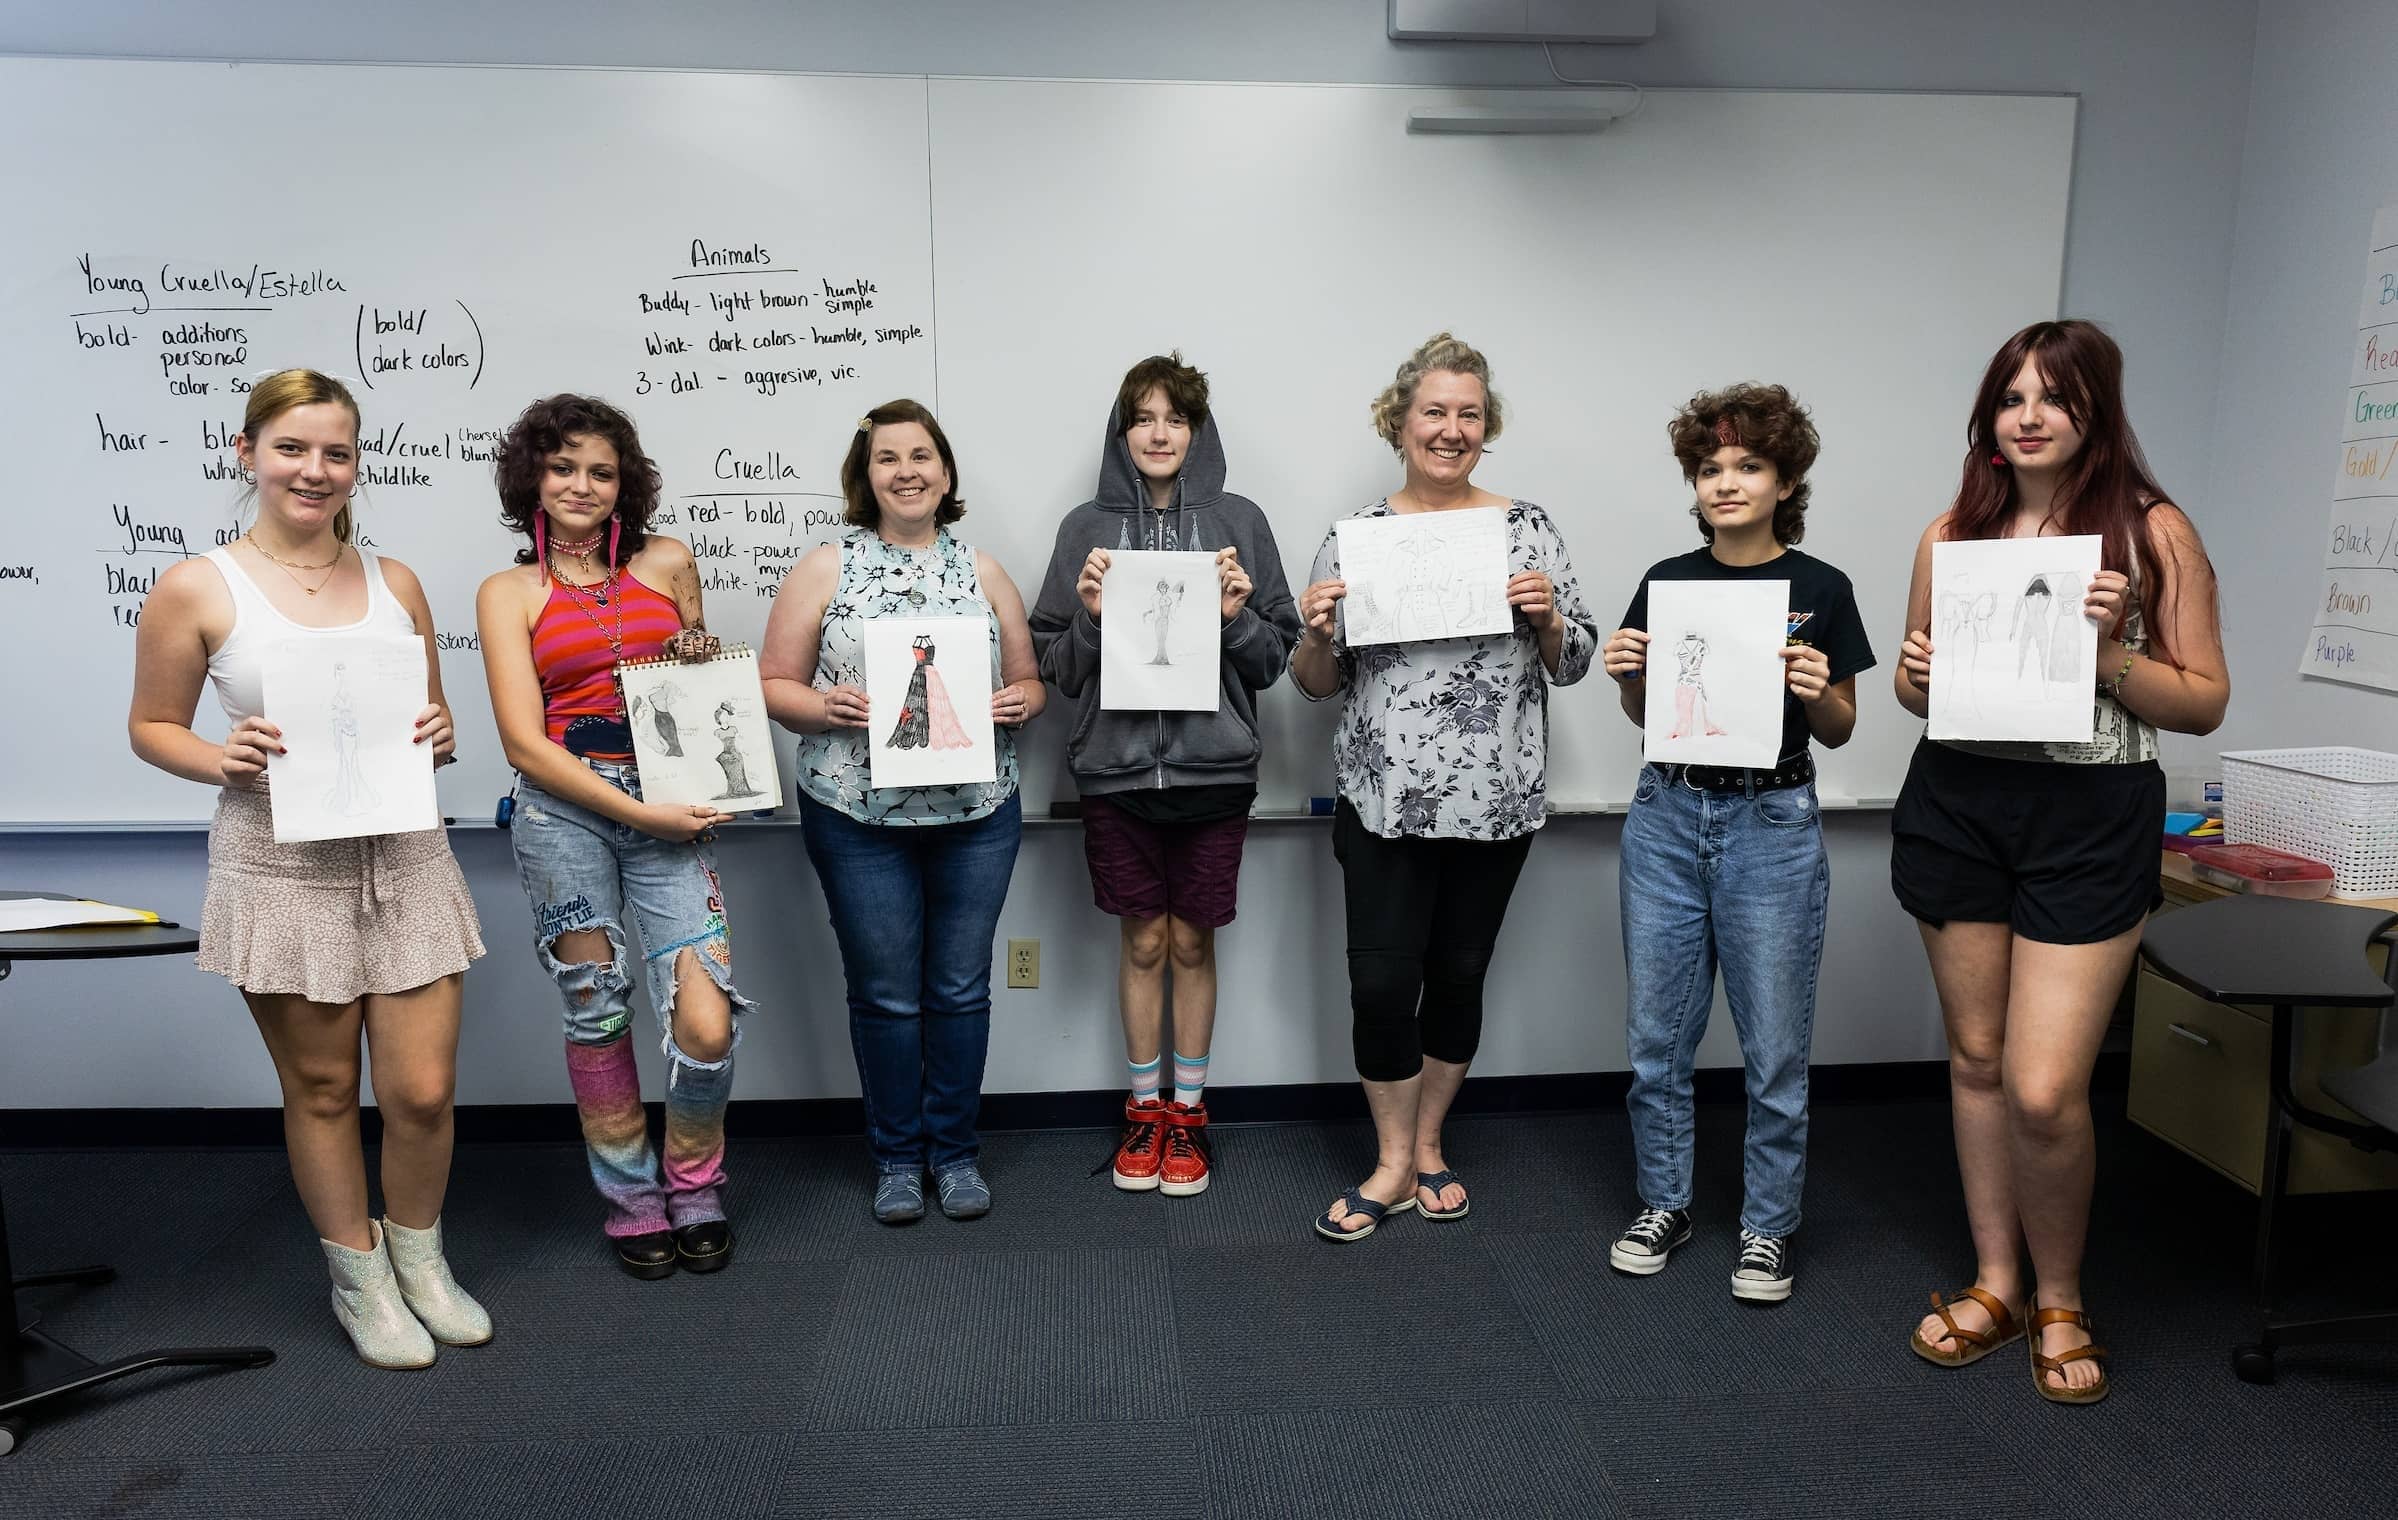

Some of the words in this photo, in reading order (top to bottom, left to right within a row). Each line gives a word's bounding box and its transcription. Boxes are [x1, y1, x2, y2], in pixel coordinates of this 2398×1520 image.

[691, 239, 771, 267] Animals
[77, 252, 150, 315] Young
[710, 292, 755, 322] light
[822, 278, 878, 299] humble
[162, 321, 248, 345] additions
[708, 330, 748, 352] dark
[810, 326, 867, 347] humble,
[876, 324, 923, 344] simple
[160, 347, 247, 378] personal
[372, 344, 414, 371] dark
[744, 368, 822, 396] aggresive,
[830, 364, 861, 382] vic.
[96, 413, 147, 452] hair
[356, 464, 433, 487] childlike
[714, 448, 800, 480] Cruella
[112, 504, 187, 560] Young
[690, 531, 737, 559] black
[2326, 582, 2371, 615] Brown
[2314, 635, 2355, 668] Purple
[537, 894, 590, 924] Friends
[575, 905, 595, 924] LIE
